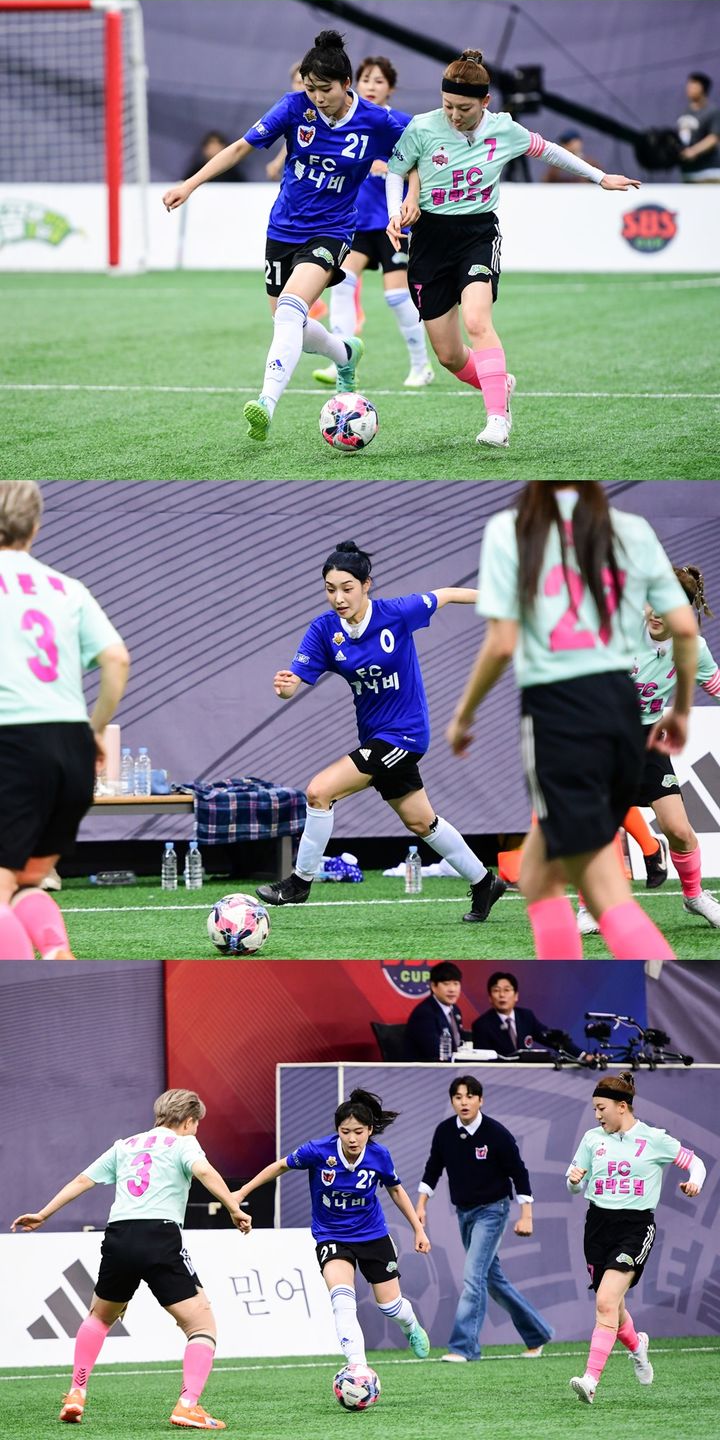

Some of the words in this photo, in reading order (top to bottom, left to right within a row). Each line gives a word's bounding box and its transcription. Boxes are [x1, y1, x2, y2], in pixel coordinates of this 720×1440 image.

[341, 133, 369, 159] 21
[484, 138, 497, 161] 7
[309, 155, 337, 172] FC
[452, 167, 483, 188] FC
[265, 259, 281, 286] 21
[413, 284, 423, 308] 7
[21, 608, 59, 683] 3
[380, 628, 395, 654] 0
[356, 665, 382, 678] FC
[400, 970, 431, 983] CUP
[634, 1138, 647, 1158] 7
[127, 1152, 153, 1197] 3
[355, 1169, 376, 1189] 21
[607, 1161, 631, 1176] FC
[229, 1267, 311, 1319] 믿어
